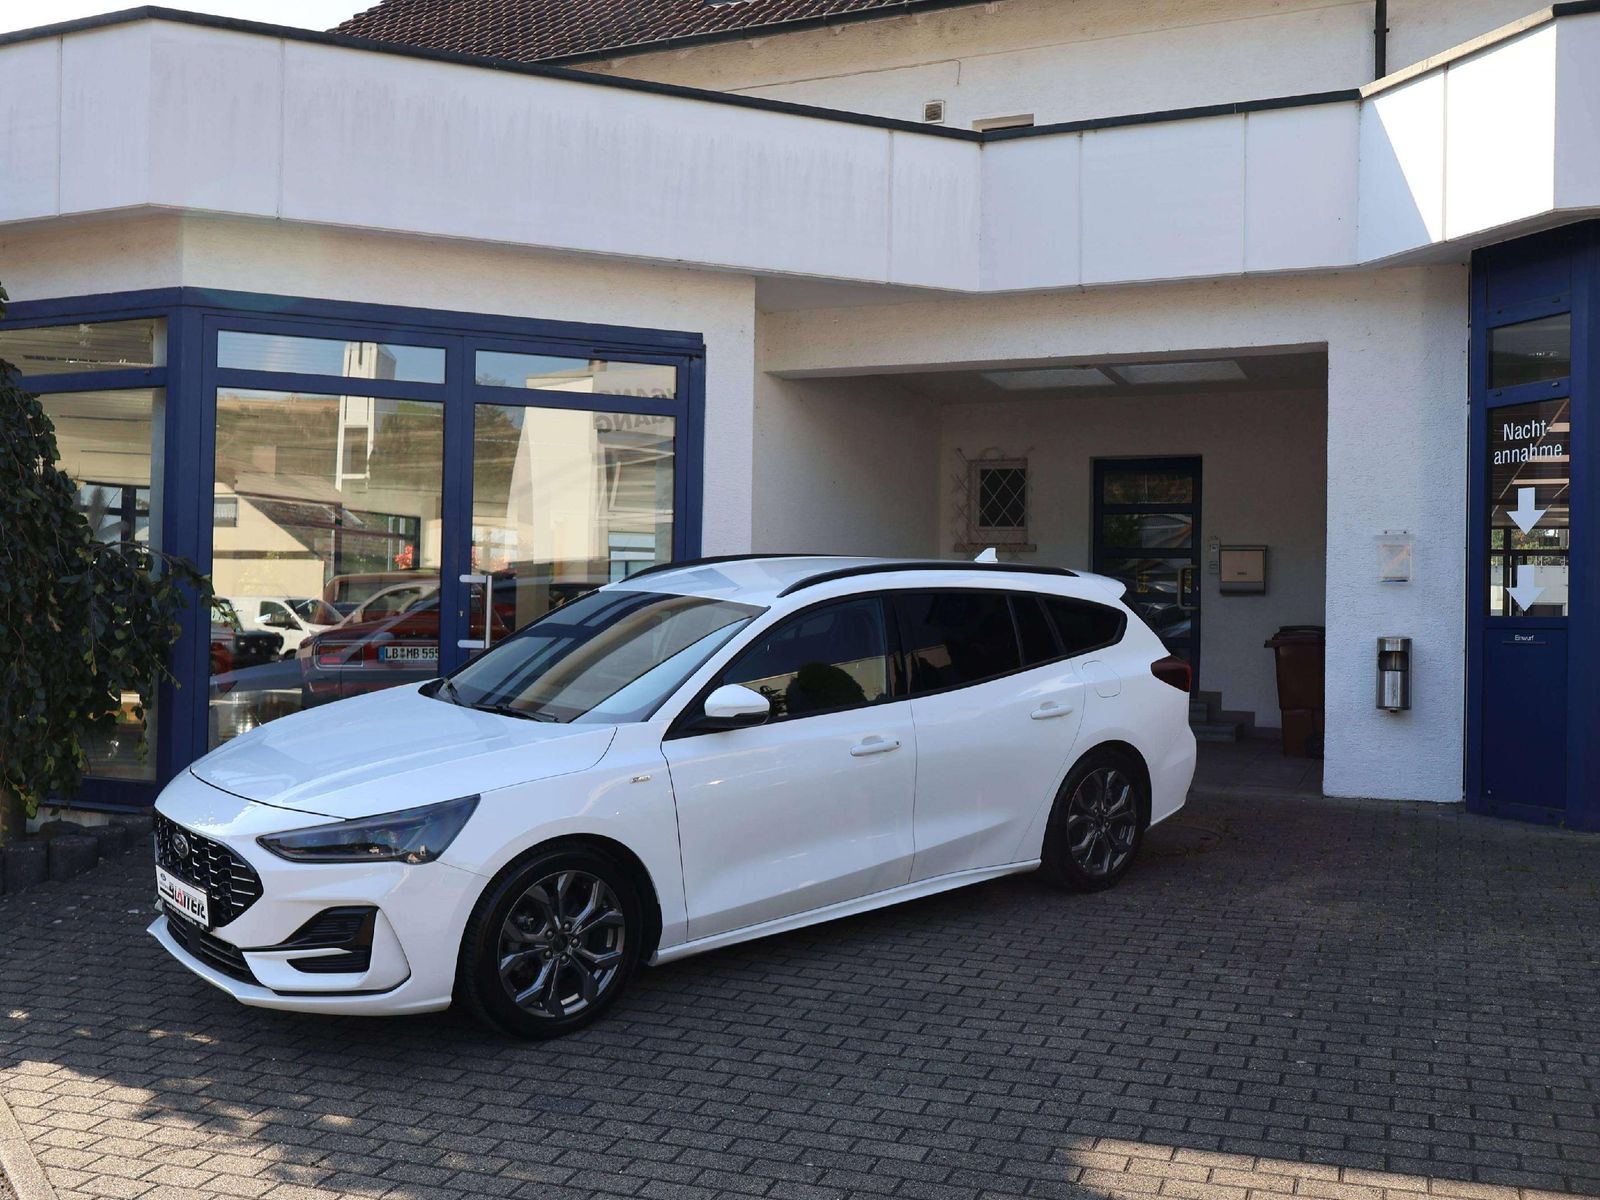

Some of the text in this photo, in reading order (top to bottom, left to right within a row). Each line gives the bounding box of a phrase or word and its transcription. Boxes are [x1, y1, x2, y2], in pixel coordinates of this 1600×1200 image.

[1503, 419, 1552, 441] Nacht-
[1493, 442, 1563, 465] annahme
[385, 647, 399, 659] LB
[406, 647, 420, 659] MB
